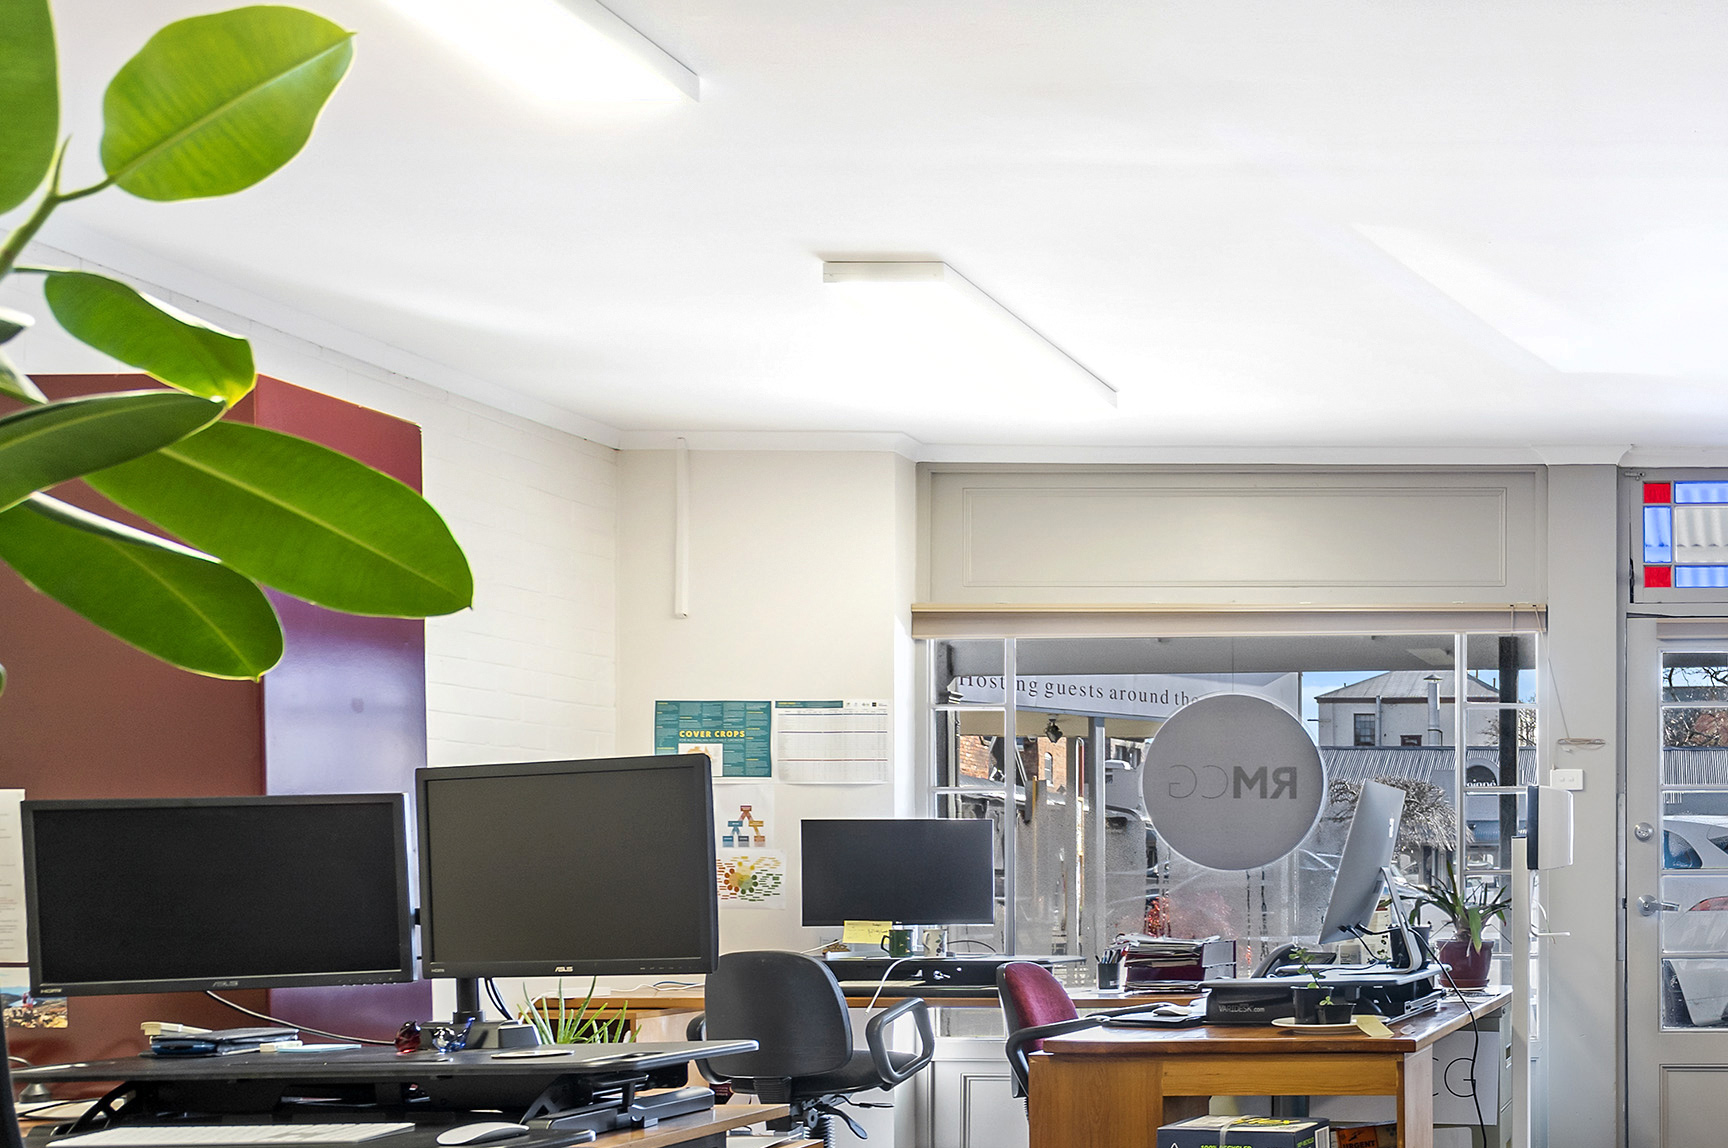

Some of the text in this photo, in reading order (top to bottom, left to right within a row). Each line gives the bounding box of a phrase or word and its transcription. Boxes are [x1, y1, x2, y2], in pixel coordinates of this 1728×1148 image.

[959, 676, 1038, 697] Hostng
[1044, 680, 1104, 698] guests
[1110, 688, 1169, 705] around
[679, 730, 746, 738] COVER CROPS
